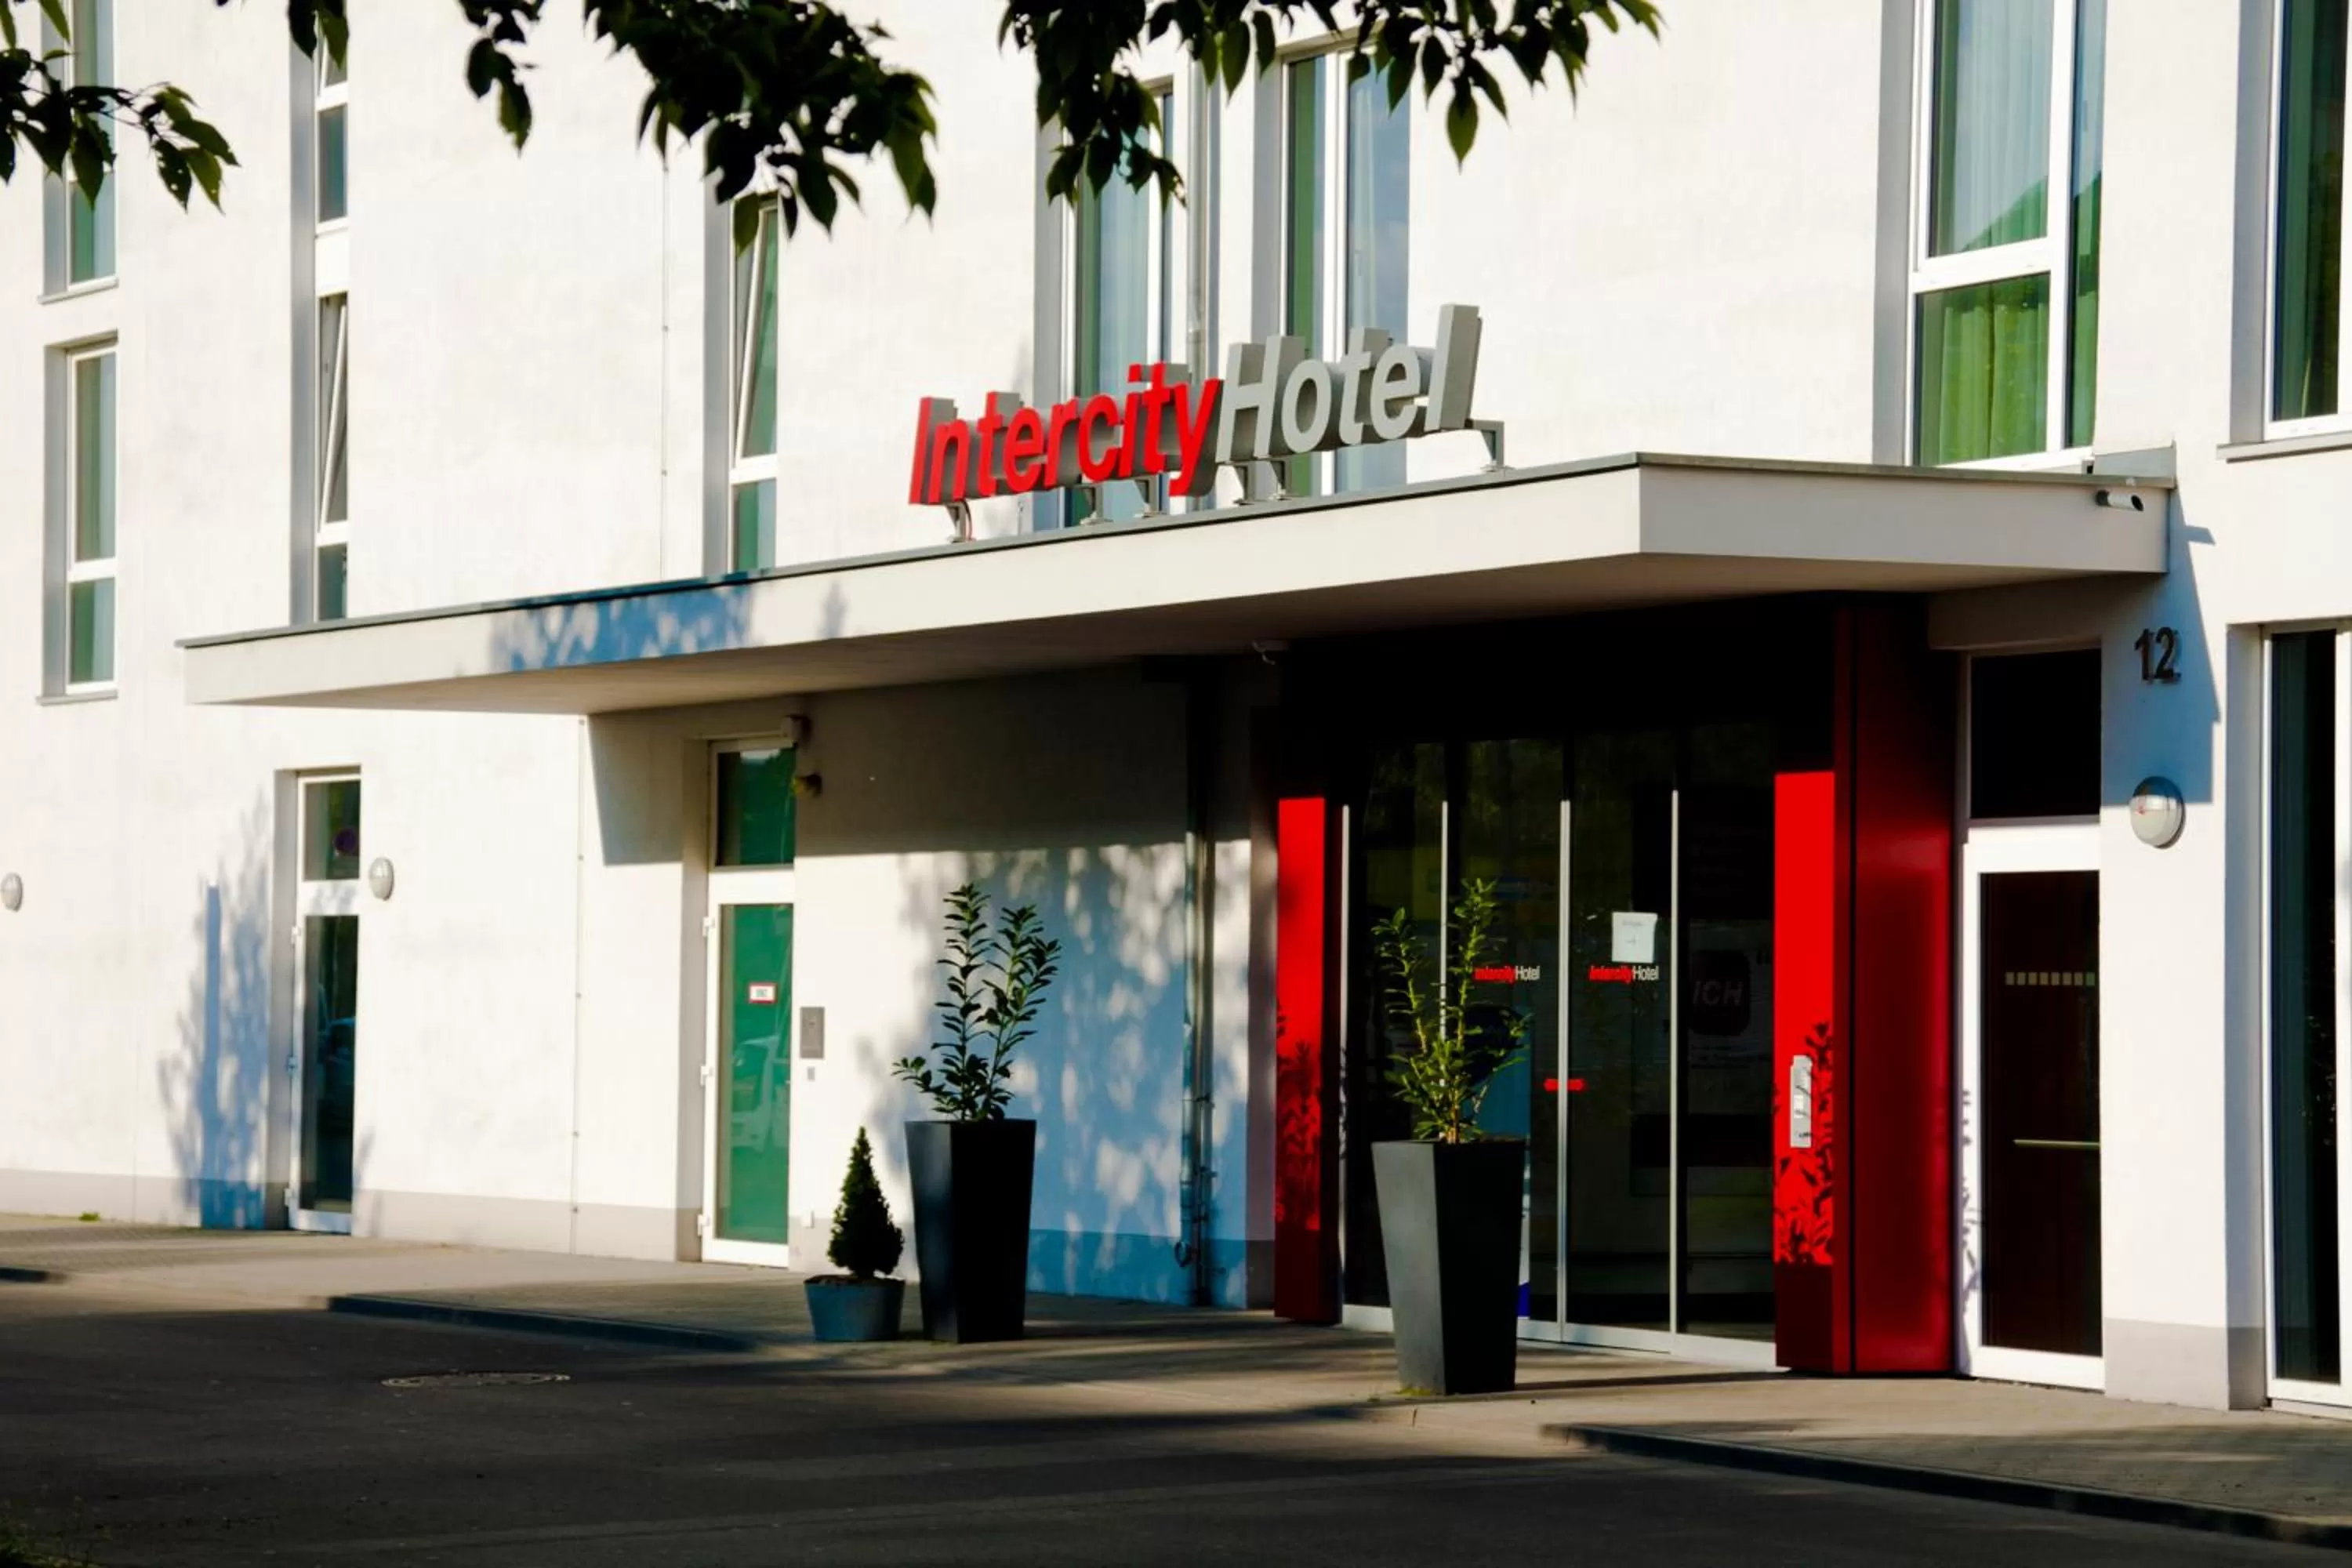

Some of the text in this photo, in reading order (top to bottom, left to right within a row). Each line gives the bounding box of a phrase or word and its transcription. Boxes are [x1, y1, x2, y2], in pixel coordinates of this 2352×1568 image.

[909, 303, 1481, 504] IntercityHotel
[2134, 627, 2181, 682] 12
[1588, 964, 1660, 984] IntercityHotel
